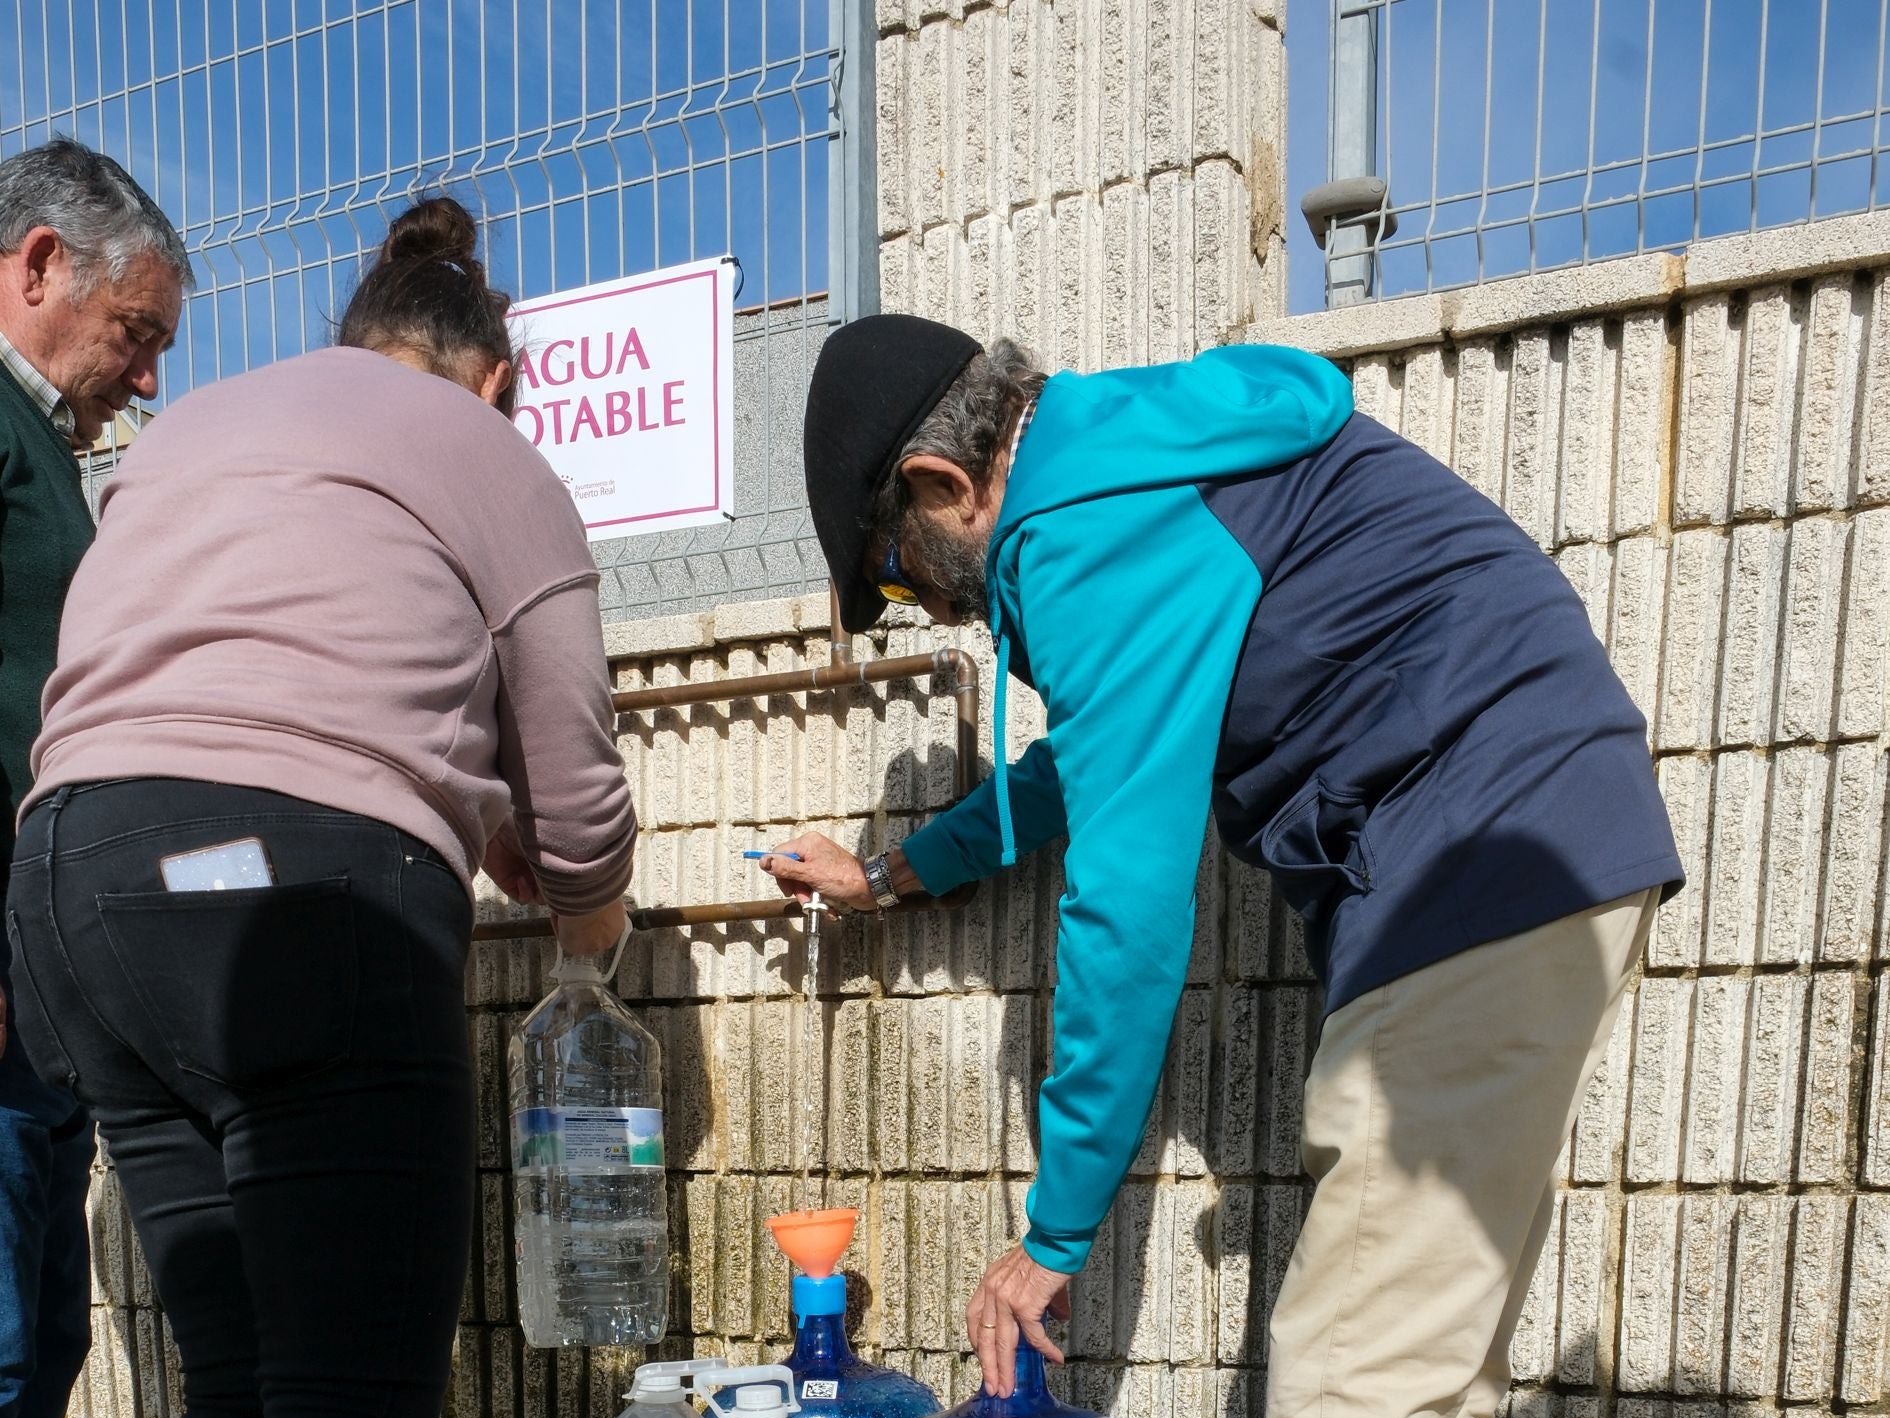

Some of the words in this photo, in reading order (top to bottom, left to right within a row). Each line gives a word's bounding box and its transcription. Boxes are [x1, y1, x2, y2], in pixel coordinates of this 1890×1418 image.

[518, 327, 651, 390] AGUA
[513, 380, 686, 448] OTABLE
[574, 489, 599, 499] Puerto
[600, 485, 616, 496] Real
